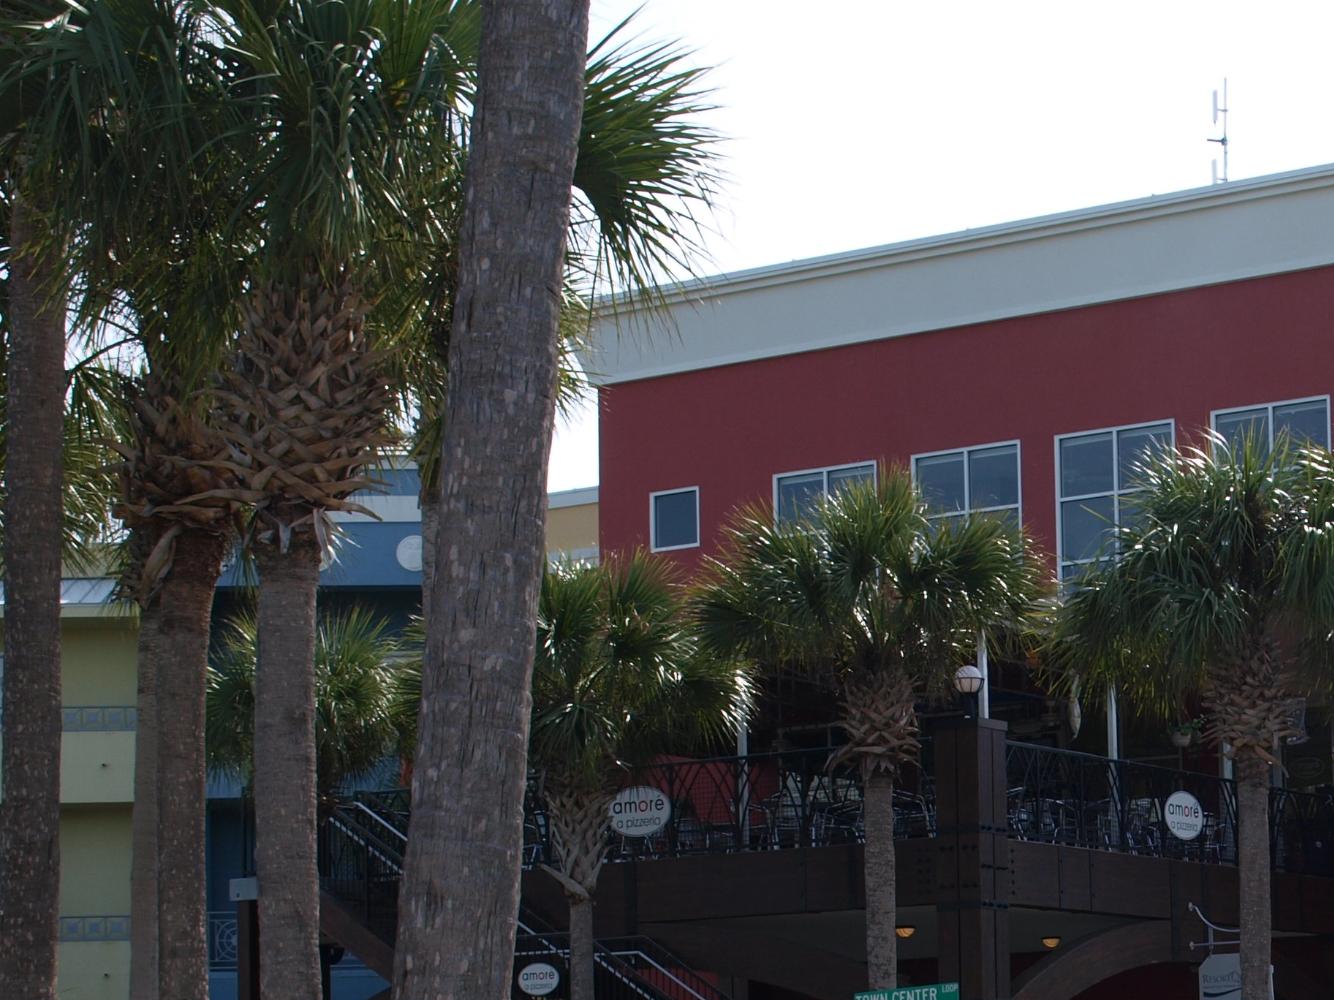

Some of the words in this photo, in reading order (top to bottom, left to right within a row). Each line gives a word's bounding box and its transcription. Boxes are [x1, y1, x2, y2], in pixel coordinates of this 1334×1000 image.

[613, 794, 664, 814] amoré
[626, 816, 661, 830] pizzeria
[941, 983, 959, 993] LOOP
